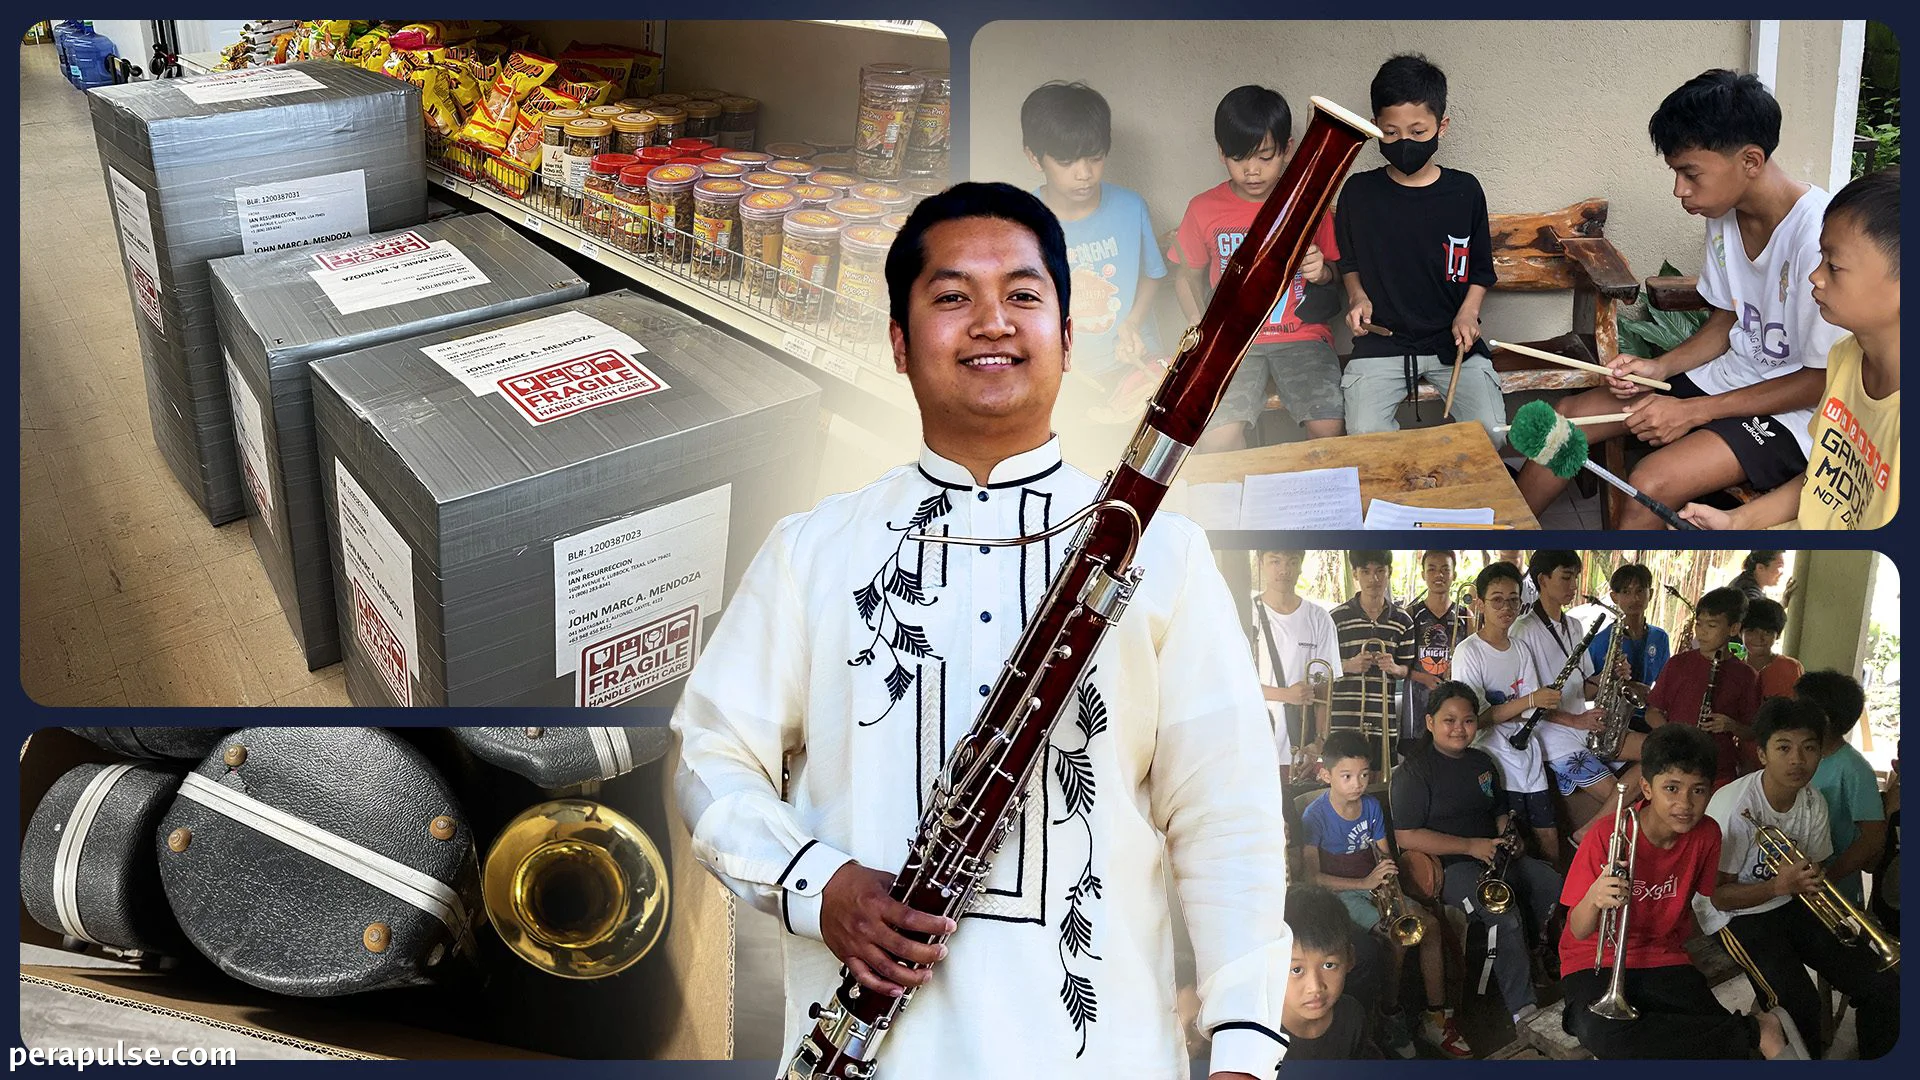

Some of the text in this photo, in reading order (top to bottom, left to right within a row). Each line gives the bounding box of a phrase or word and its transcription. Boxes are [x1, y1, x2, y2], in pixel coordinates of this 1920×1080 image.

[262, 191, 300, 204] 1200387031
[277, 240, 301, 250] MARC
[312, 231, 352, 245] MENDOZA
[465, 362, 494, 374] JOHN
[496, 352, 529, 365] MARC
[542, 334, 596, 352] MENDOZA
[525, 368, 639, 408] FRAGILE
[538, 380, 650, 417] HANDLE WITH CARE
[1742, 422, 1765, 446] adidas
[1823, 399, 1889, 490] WARNING
[1820, 427, 1875, 507] GAMING
[1813, 485, 1843, 510] NOT
[1814, 455, 1867, 524] MODE
[567, 529, 642, 561] BL#: 1200387023
[568, 558, 633, 586] IAN RESURRECCION
[581, 578, 600, 589] AVENUE
[568, 571, 702, 629] JOHN MARC A. MENDOZA
[588, 660, 688, 706] HANDLE WITH CARE
[589, 639, 689, 696] FRAGILE
